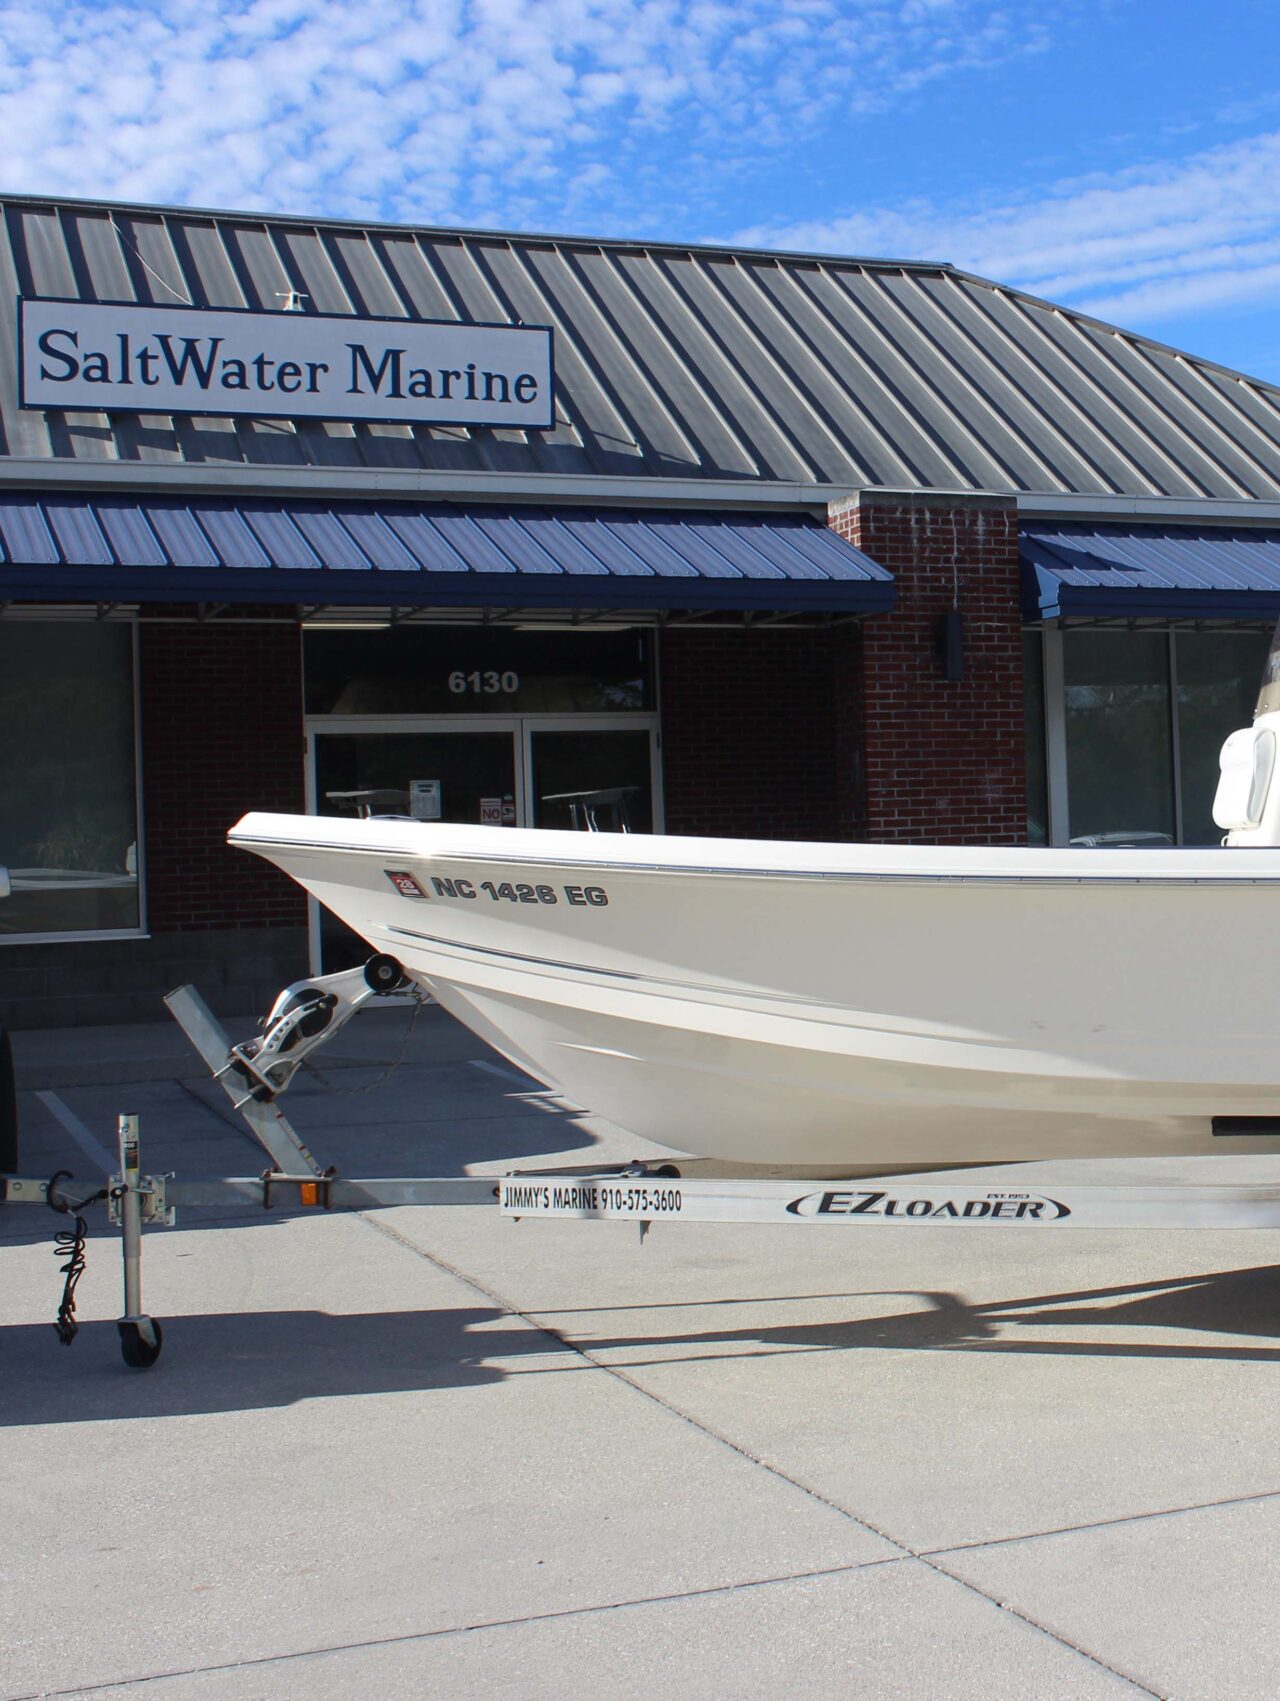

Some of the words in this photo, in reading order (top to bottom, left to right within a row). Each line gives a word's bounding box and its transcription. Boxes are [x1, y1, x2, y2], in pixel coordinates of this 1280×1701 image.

[38, 329, 329, 394] SaltWater
[344, 343, 538, 404] Marine
[449, 671, 519, 694] 6130
[482, 807, 501, 820] NO
[431, 877, 477, 899] NC
[480, 883, 558, 905] 1426
[563, 886, 609, 907] EG
[504, 1186, 549, 1209] JIMMY'S
[553, 1187, 598, 1210] MARINE
[601, 1188, 682, 1212] 910-575-3600
